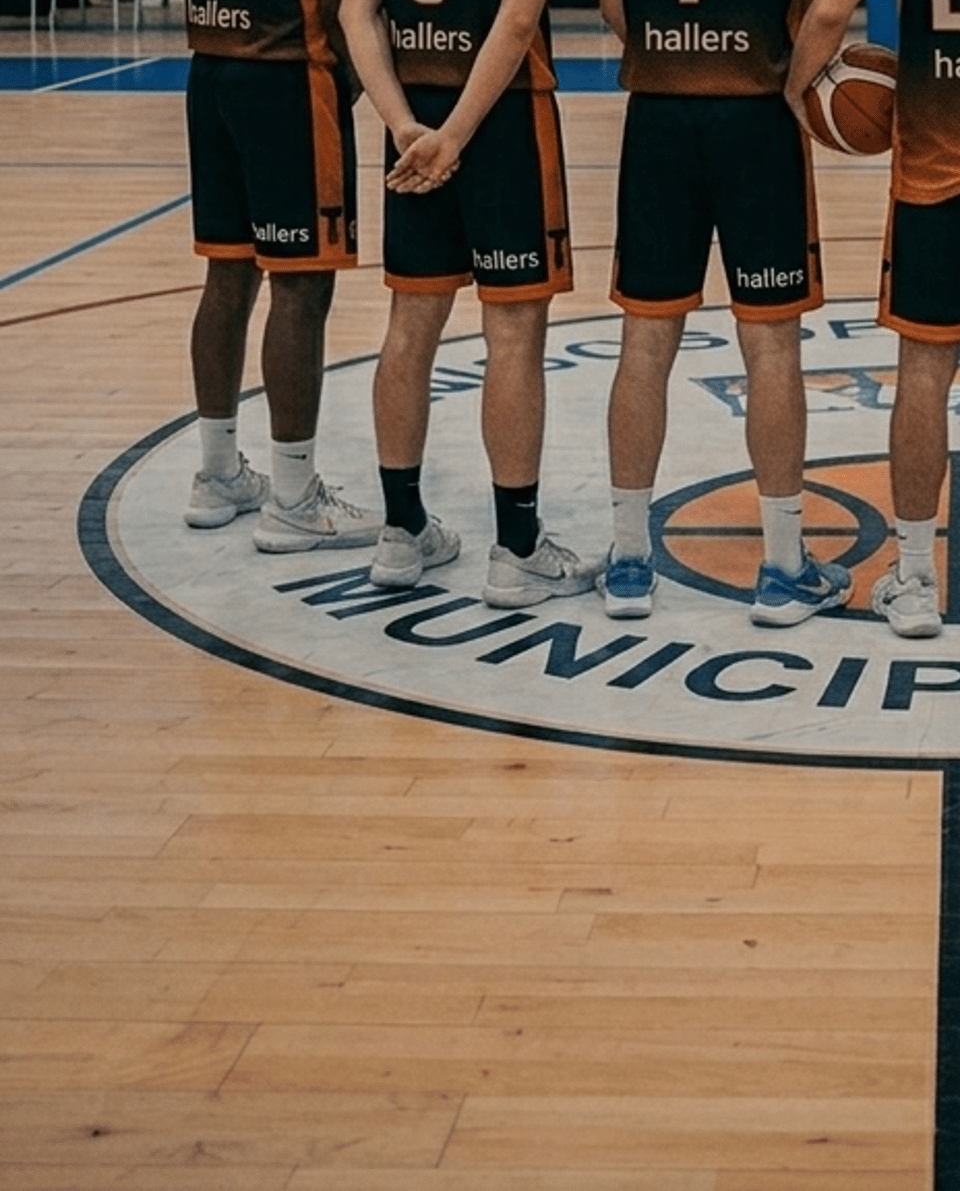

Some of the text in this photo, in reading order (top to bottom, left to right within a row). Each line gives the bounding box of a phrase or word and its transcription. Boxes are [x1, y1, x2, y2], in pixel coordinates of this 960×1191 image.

[645, 21, 750, 52] hallers
[473, 248, 539, 270] hallers
[736, 267, 804, 289] hallers
